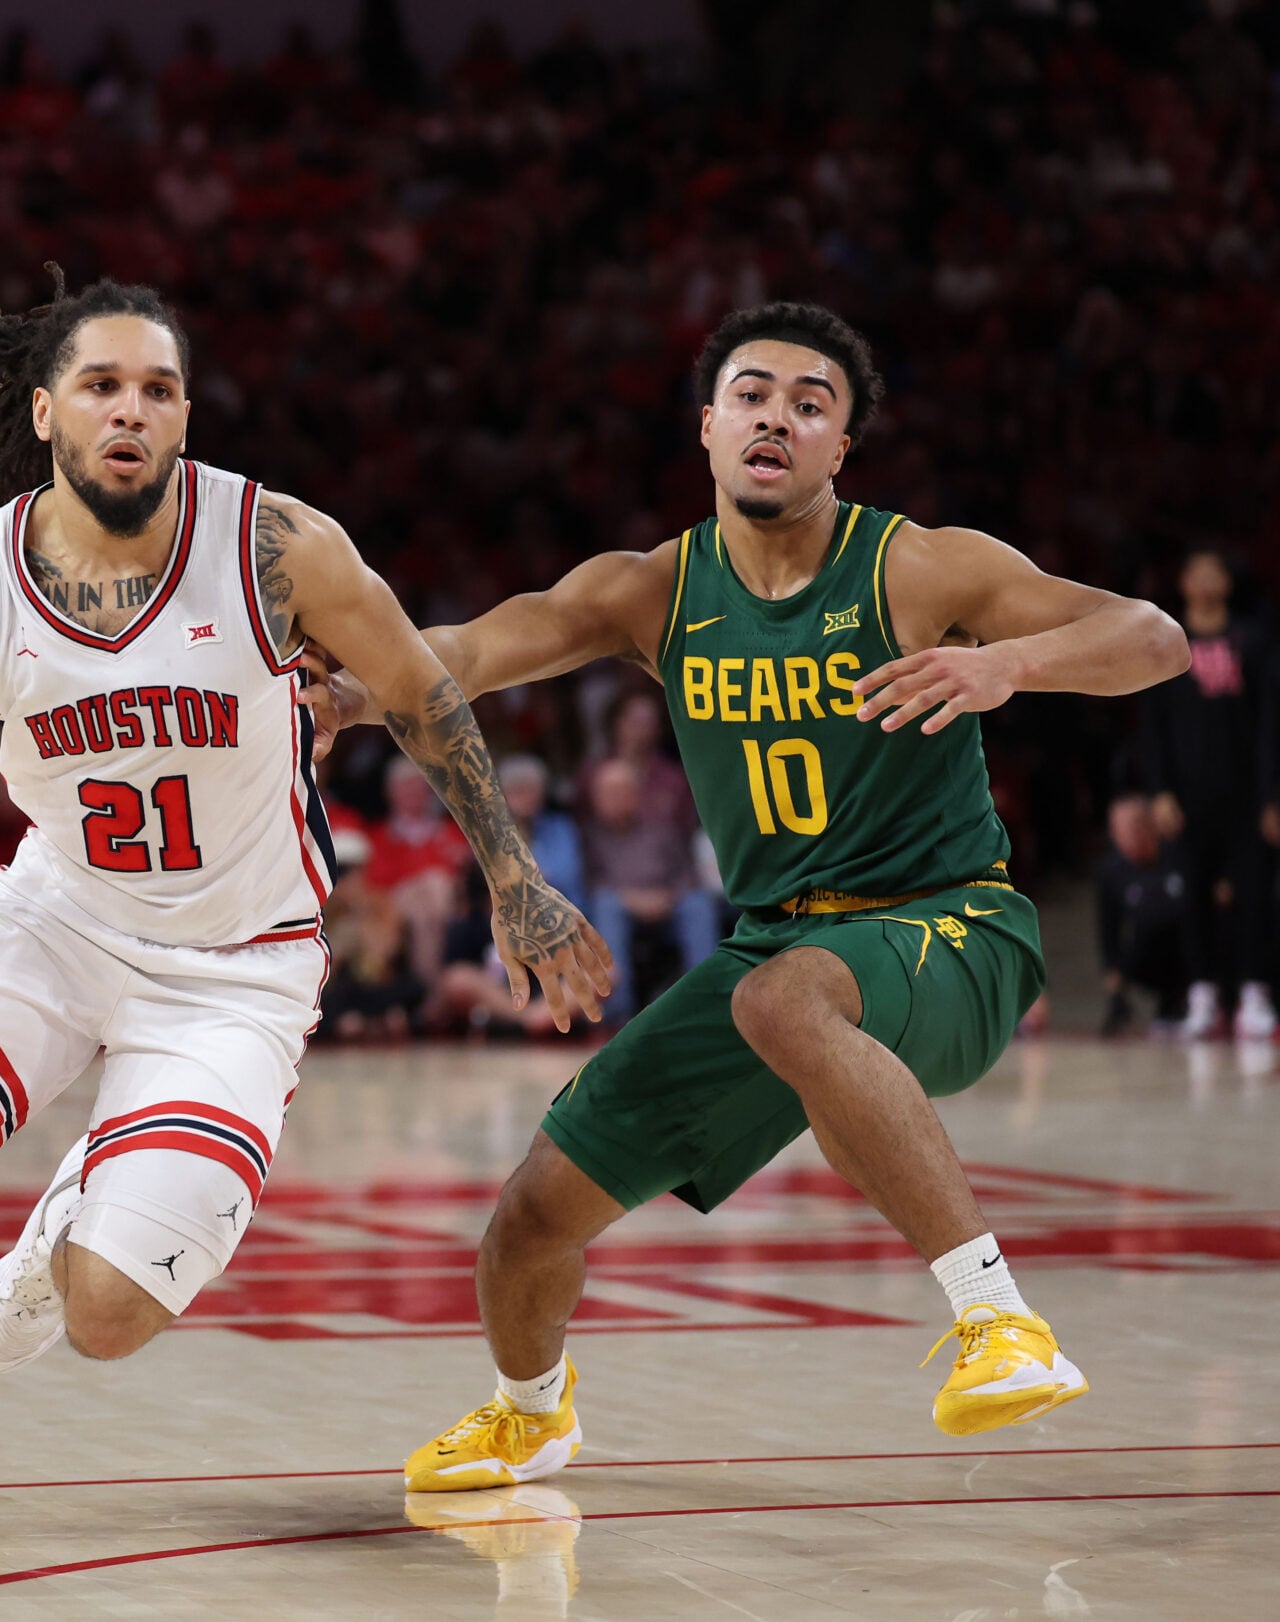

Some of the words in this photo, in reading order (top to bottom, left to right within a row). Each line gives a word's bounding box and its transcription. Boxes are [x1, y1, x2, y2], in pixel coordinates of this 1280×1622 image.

[78, 582, 102, 611] IN
[24, 685, 239, 760] HOUSTON
[684, 652, 865, 722] BEARS
[77, 774, 203, 873] 21
[742, 738, 828, 836] 10
